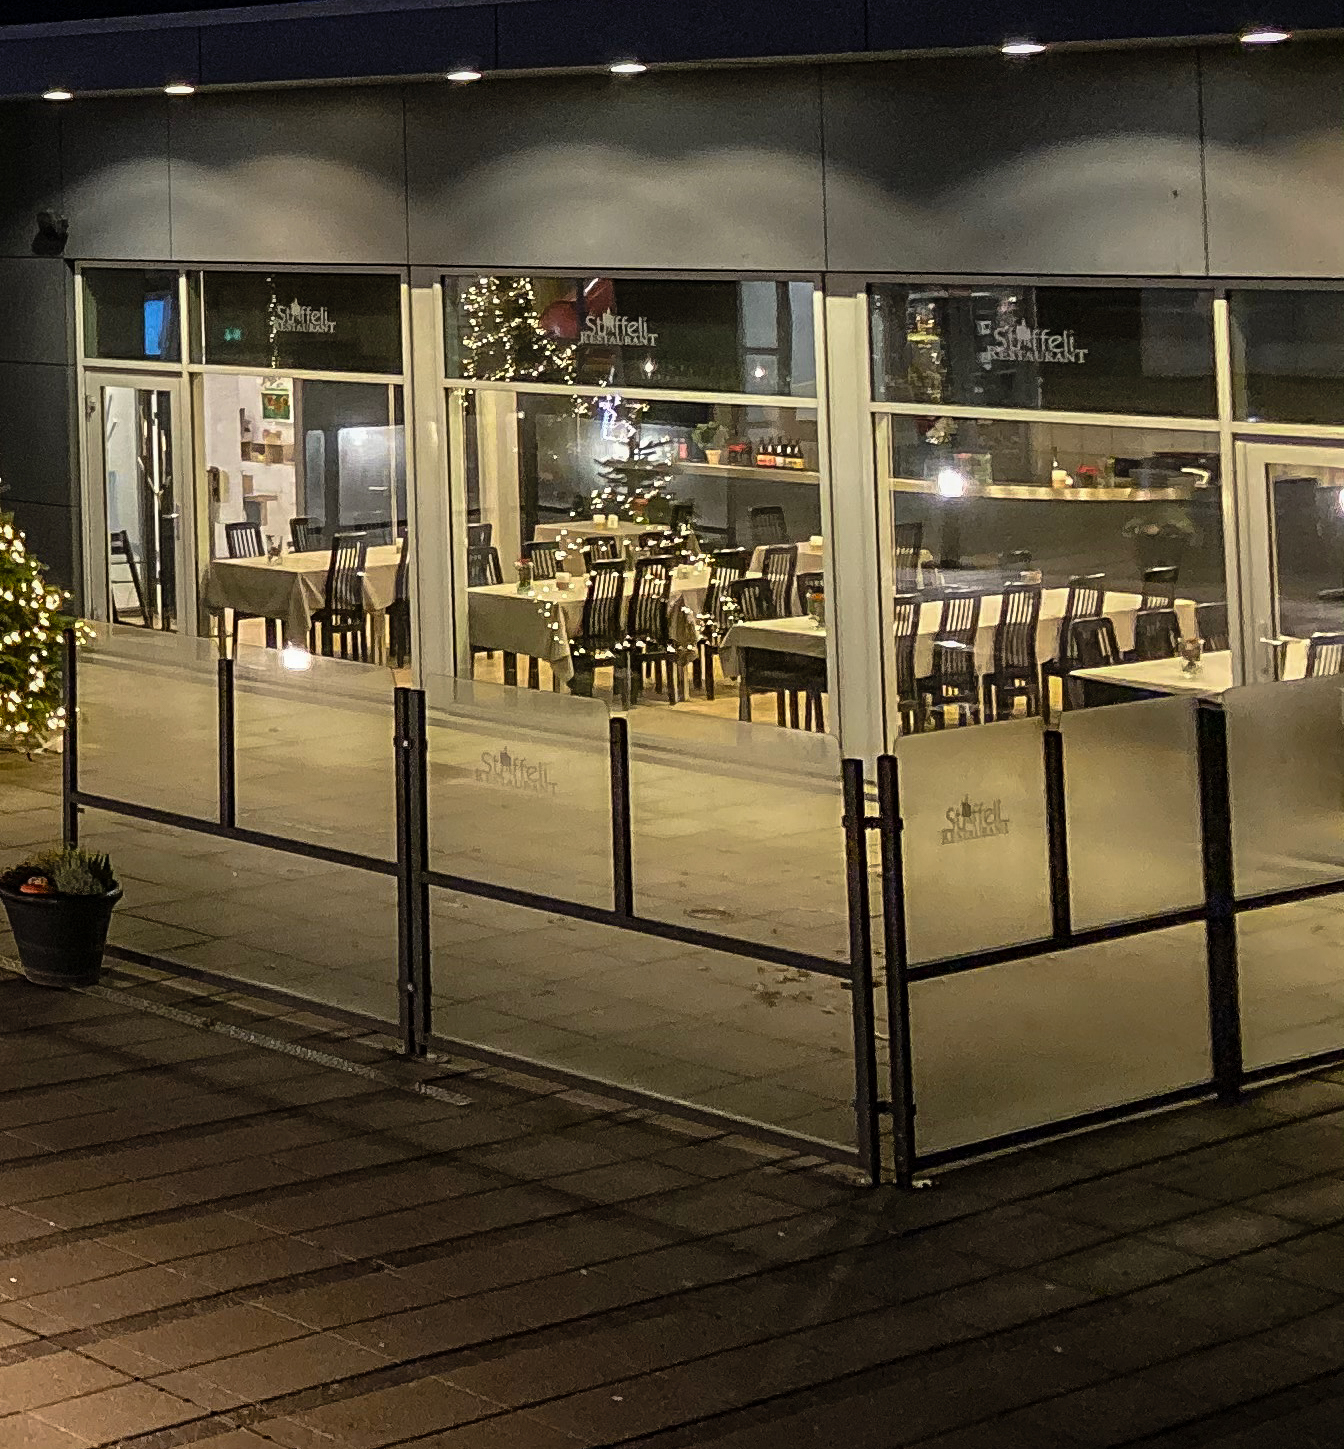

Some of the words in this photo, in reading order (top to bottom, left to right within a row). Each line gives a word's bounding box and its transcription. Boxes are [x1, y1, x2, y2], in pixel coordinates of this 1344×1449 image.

[273, 320, 336, 334] RESTAURANT
[577, 331, 658, 346] RESTAURANT
[987, 346, 1088, 363] RESTAURANT
